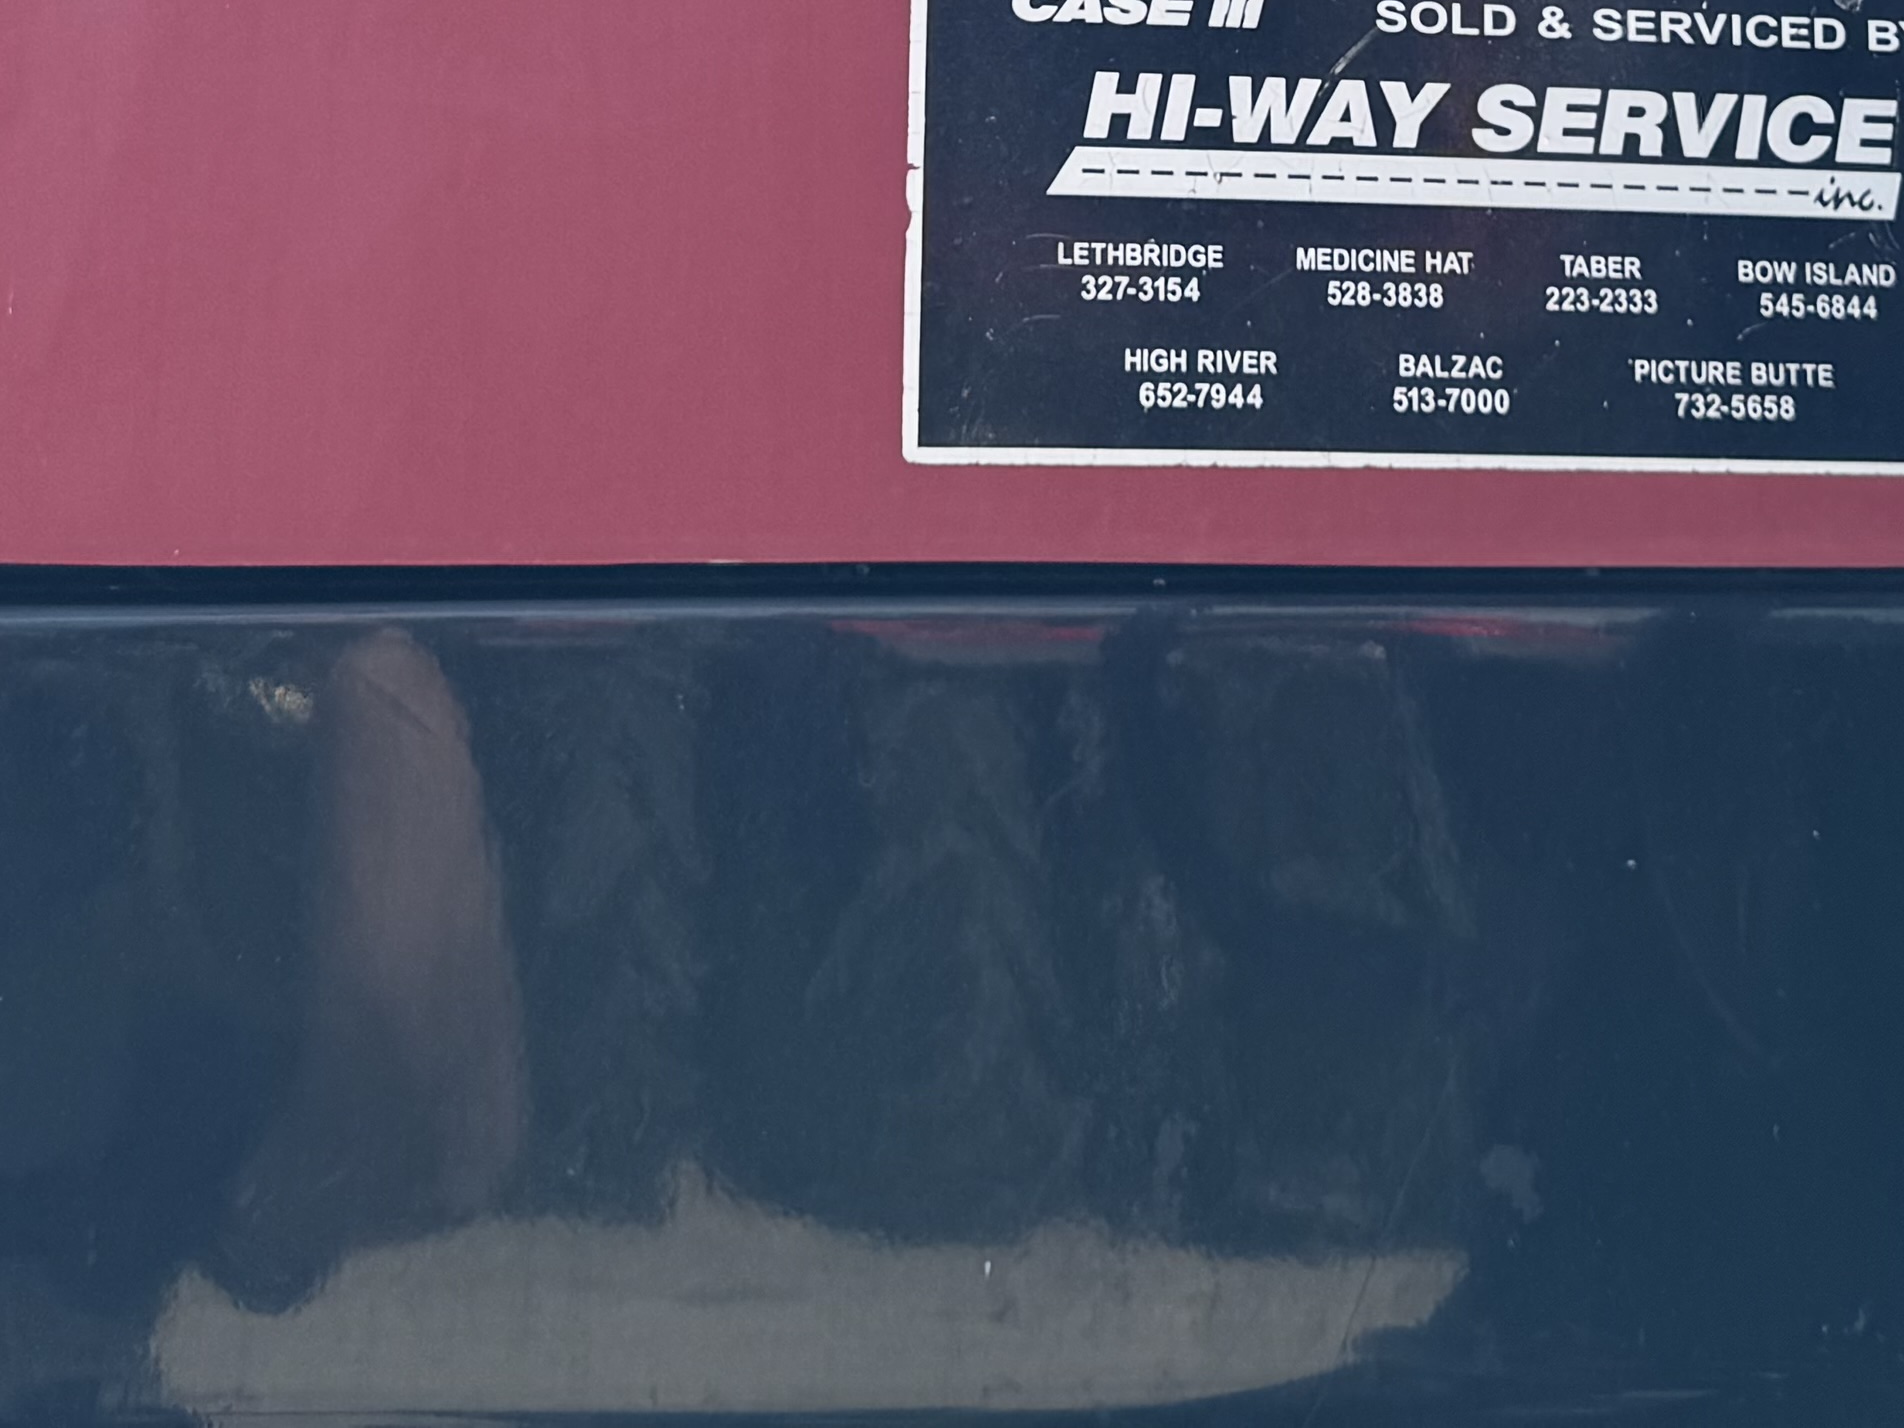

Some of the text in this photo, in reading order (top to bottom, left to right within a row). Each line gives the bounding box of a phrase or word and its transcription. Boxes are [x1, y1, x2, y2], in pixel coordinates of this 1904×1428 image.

[1375, 0, 1517, 37] SOLD
[1537, 5, 1573, 39] &
[1592, 8, 1846, 50] SERVICED
[1082, 70, 1895, 165] HI-WAY SERVICE
[1814, 175, 1882, 212] inc.
[1057, 241, 1224, 269] LETHBRIDGE
[1296, 246, 1474, 275] MEDICINE HAT
[1559, 254, 1642, 280] TABER
[1737, 259, 1896, 288] BOW ISLAND
[1080, 275, 1201, 303] 327-3154
[1327, 280, 1444, 309] 528-3838
[1545, 286, 1658, 314] 223-2333
[1759, 292, 1878, 320] 545-6844
[1124, 347, 1278, 375] HIGH RIVER
[1398, 353, 1503, 380] BALZAC
[1634, 359, 1835, 388] PICTURE BUTTE
[1139, 381, 1264, 410] 652-7944
[1393, 386, 1510, 415] 513-7000
[1674, 392, 1796, 421] 732-5658
